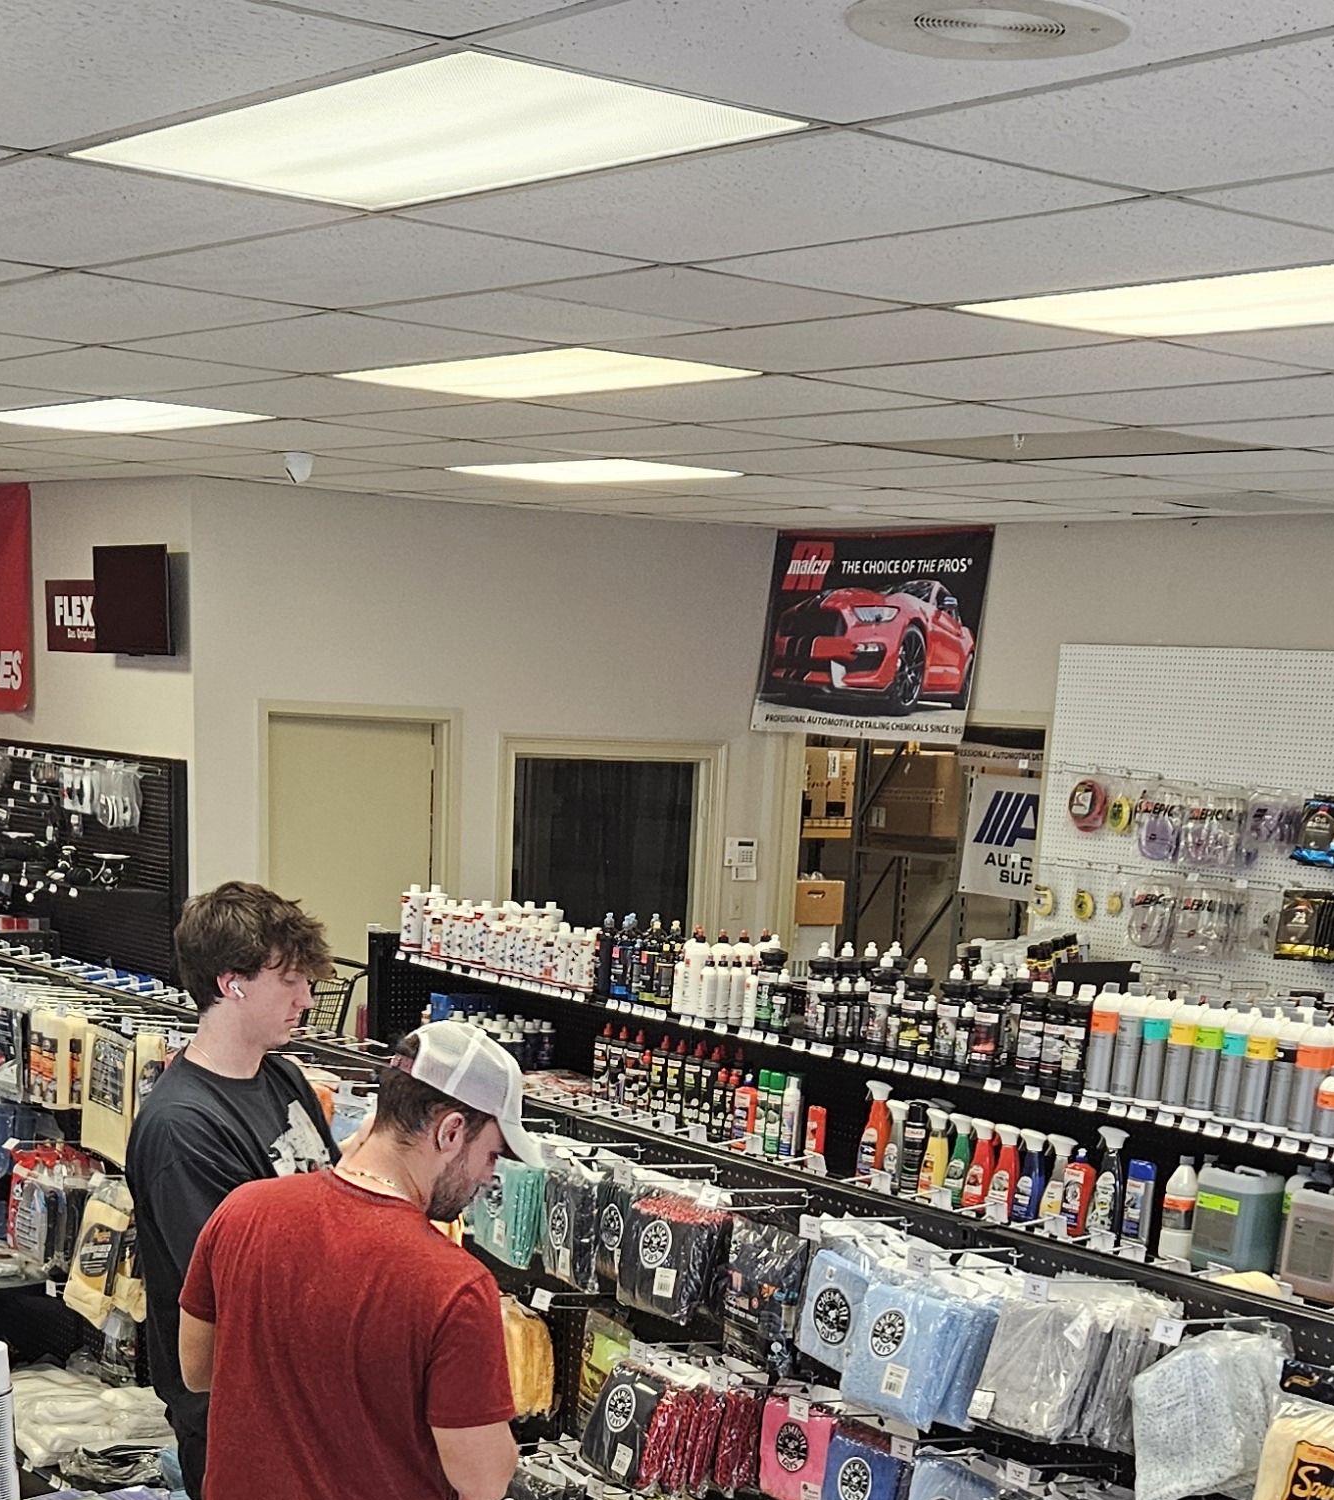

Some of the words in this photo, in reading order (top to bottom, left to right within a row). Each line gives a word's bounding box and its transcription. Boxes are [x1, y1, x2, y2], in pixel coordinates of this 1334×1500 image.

[787, 553, 831, 576] malco
[841, 561, 860, 575] THE
[862, 560, 899, 575] CHOICE
[901, 559, 916, 574] OF
[917, 558, 936, 573] THE
[937, 557, 968, 574] PROS
[54, 595, 95, 627] FLEX
[807, 715, 854, 729] AUTOMOTIVE
[855, 719, 890, 731] DETAILING
[890, 722, 929, 733] CHEMICALS
[930, 724, 949, 734] SINCE
